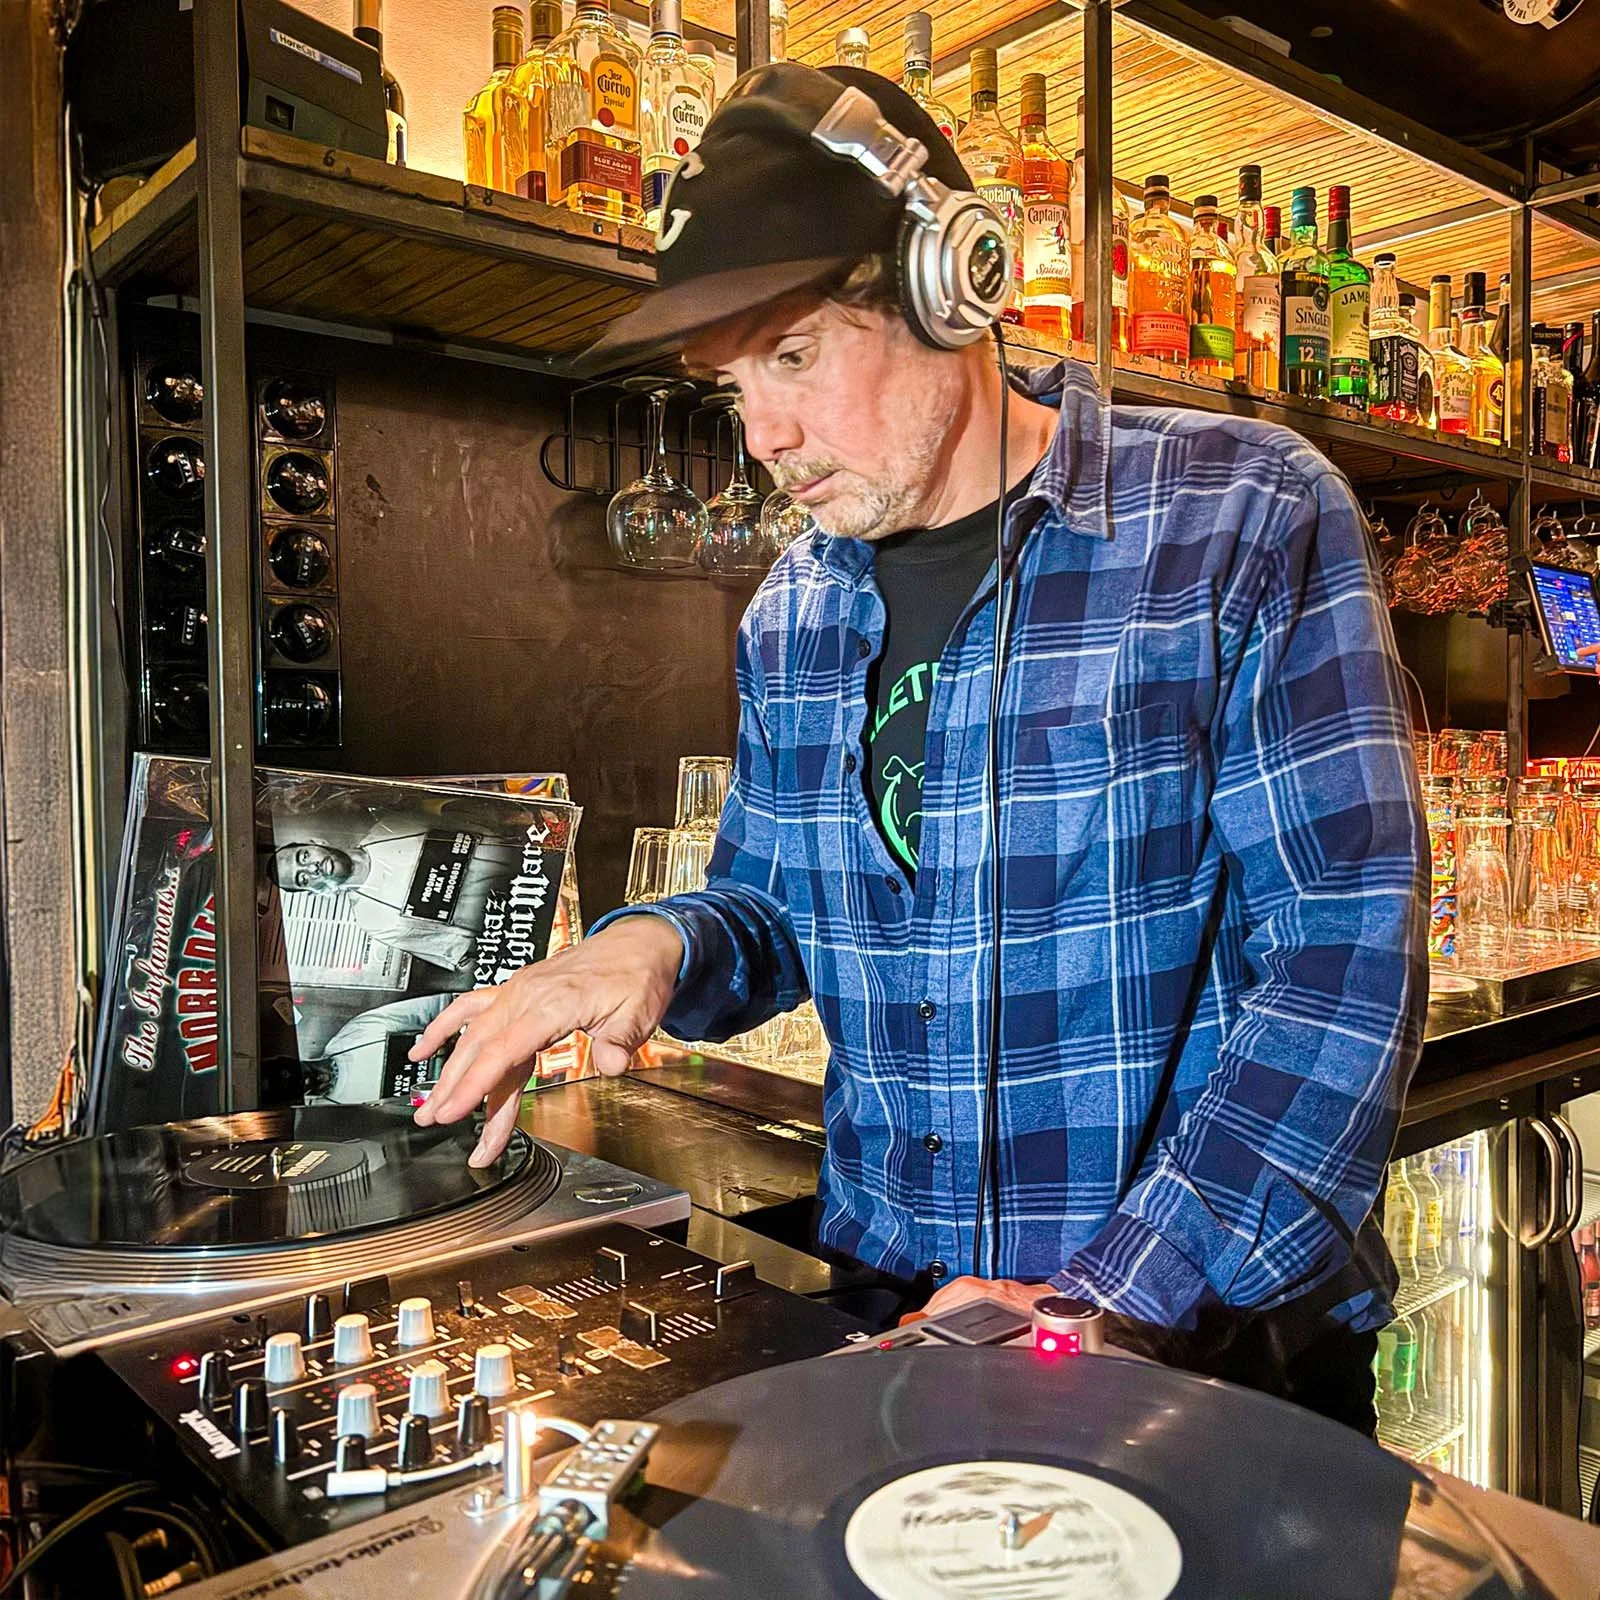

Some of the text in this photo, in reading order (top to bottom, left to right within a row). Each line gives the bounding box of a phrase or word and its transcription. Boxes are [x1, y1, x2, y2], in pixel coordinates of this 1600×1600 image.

[608, 68, 622, 81] Jose
[597, 74, 631, 98] Cuervo
[682, 100, 696, 112] Jose
[672, 105, 704, 127] Cuervo
[675, 126, 700, 137] ESPECIA
[593, 156, 611, 165] BLUE
[976, 186, 1012, 204] Captain
[1028, 207, 1061, 225] Captain
[1341, 290, 1370, 305] JAME
[1295, 307, 1330, 326] SINGLE
[1298, 346, 1314, 363] 12
[451, 832, 465, 854] MOBB
[461, 834, 473, 855] DEEP
[420, 866, 439, 903] PRODIGY
[434, 876, 445, 893] AKA
[123, 1021, 158, 1070] The
[402, 1075, 411, 1092] AKA
[179, 1408, 241, 1460] Numark
